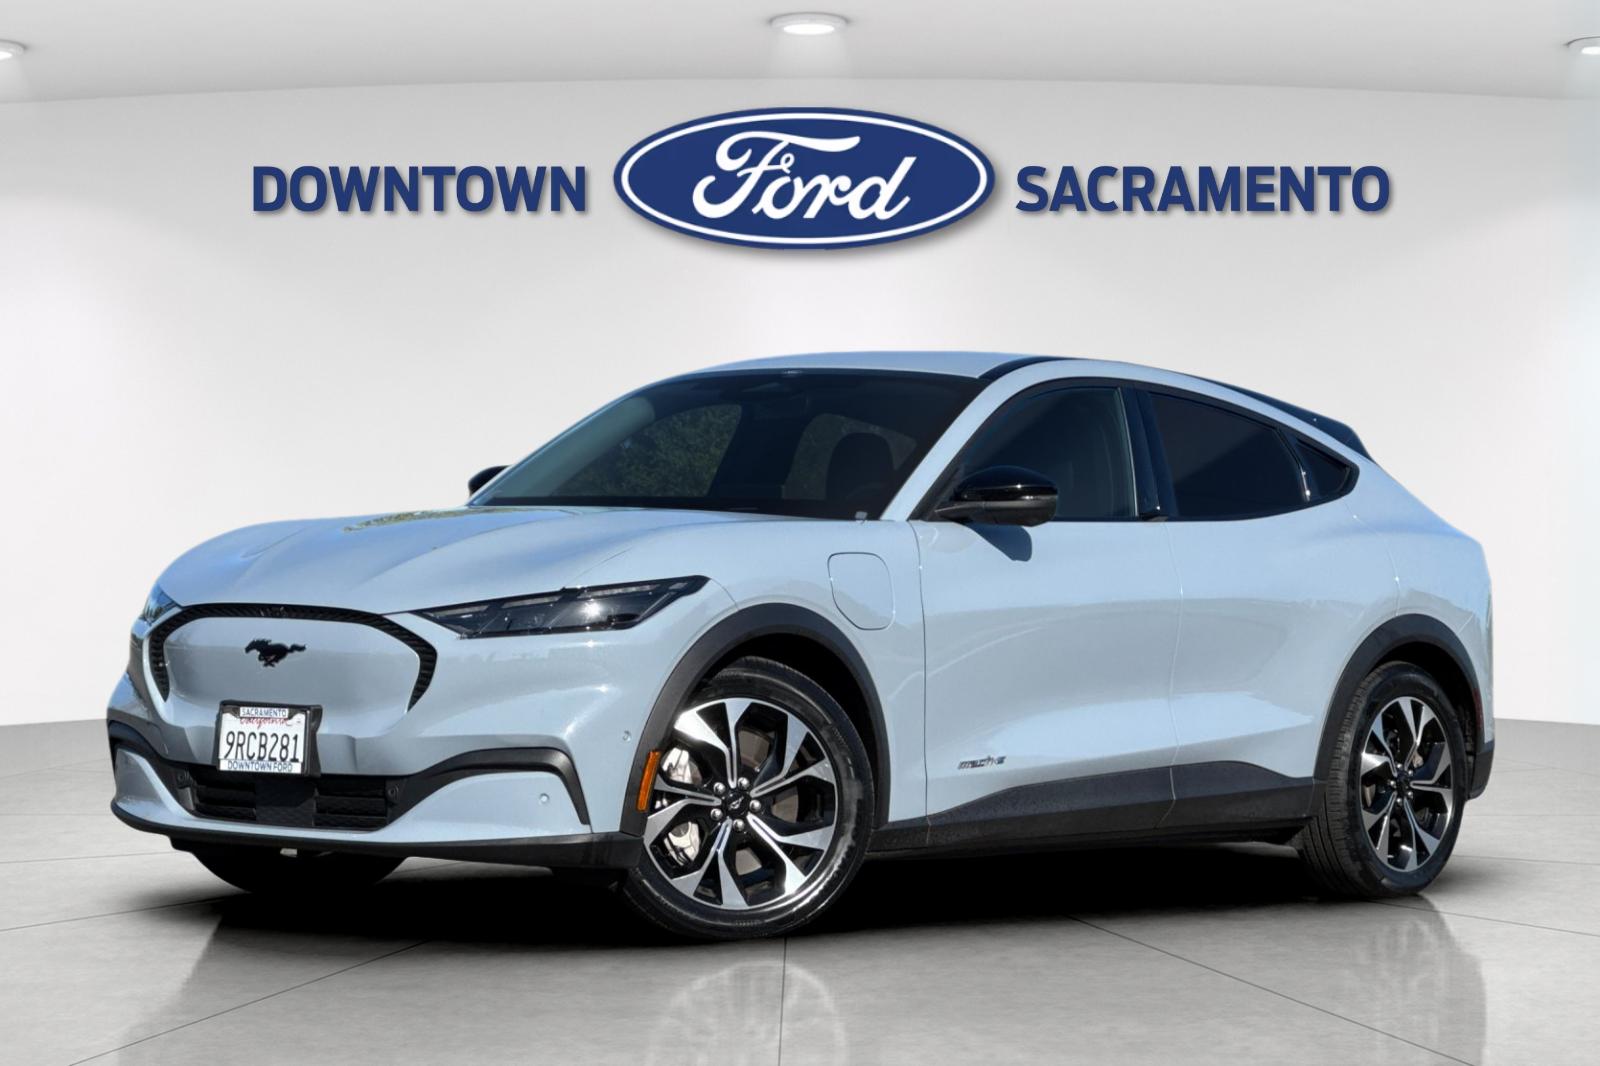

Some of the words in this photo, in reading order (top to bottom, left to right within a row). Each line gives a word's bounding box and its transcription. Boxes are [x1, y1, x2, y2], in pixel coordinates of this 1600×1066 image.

[252, 165, 586, 213] DOWNTOWN
[692, 131, 916, 220] Ford
[1016, 165, 1391, 213] SACRAMENTO
[241, 707, 287, 717] SACRAMENTO
[223, 730, 299, 763] 9RCB281
[227, 760, 272, 771] DOWNTOWN
[273, 762, 293, 772] FORD
